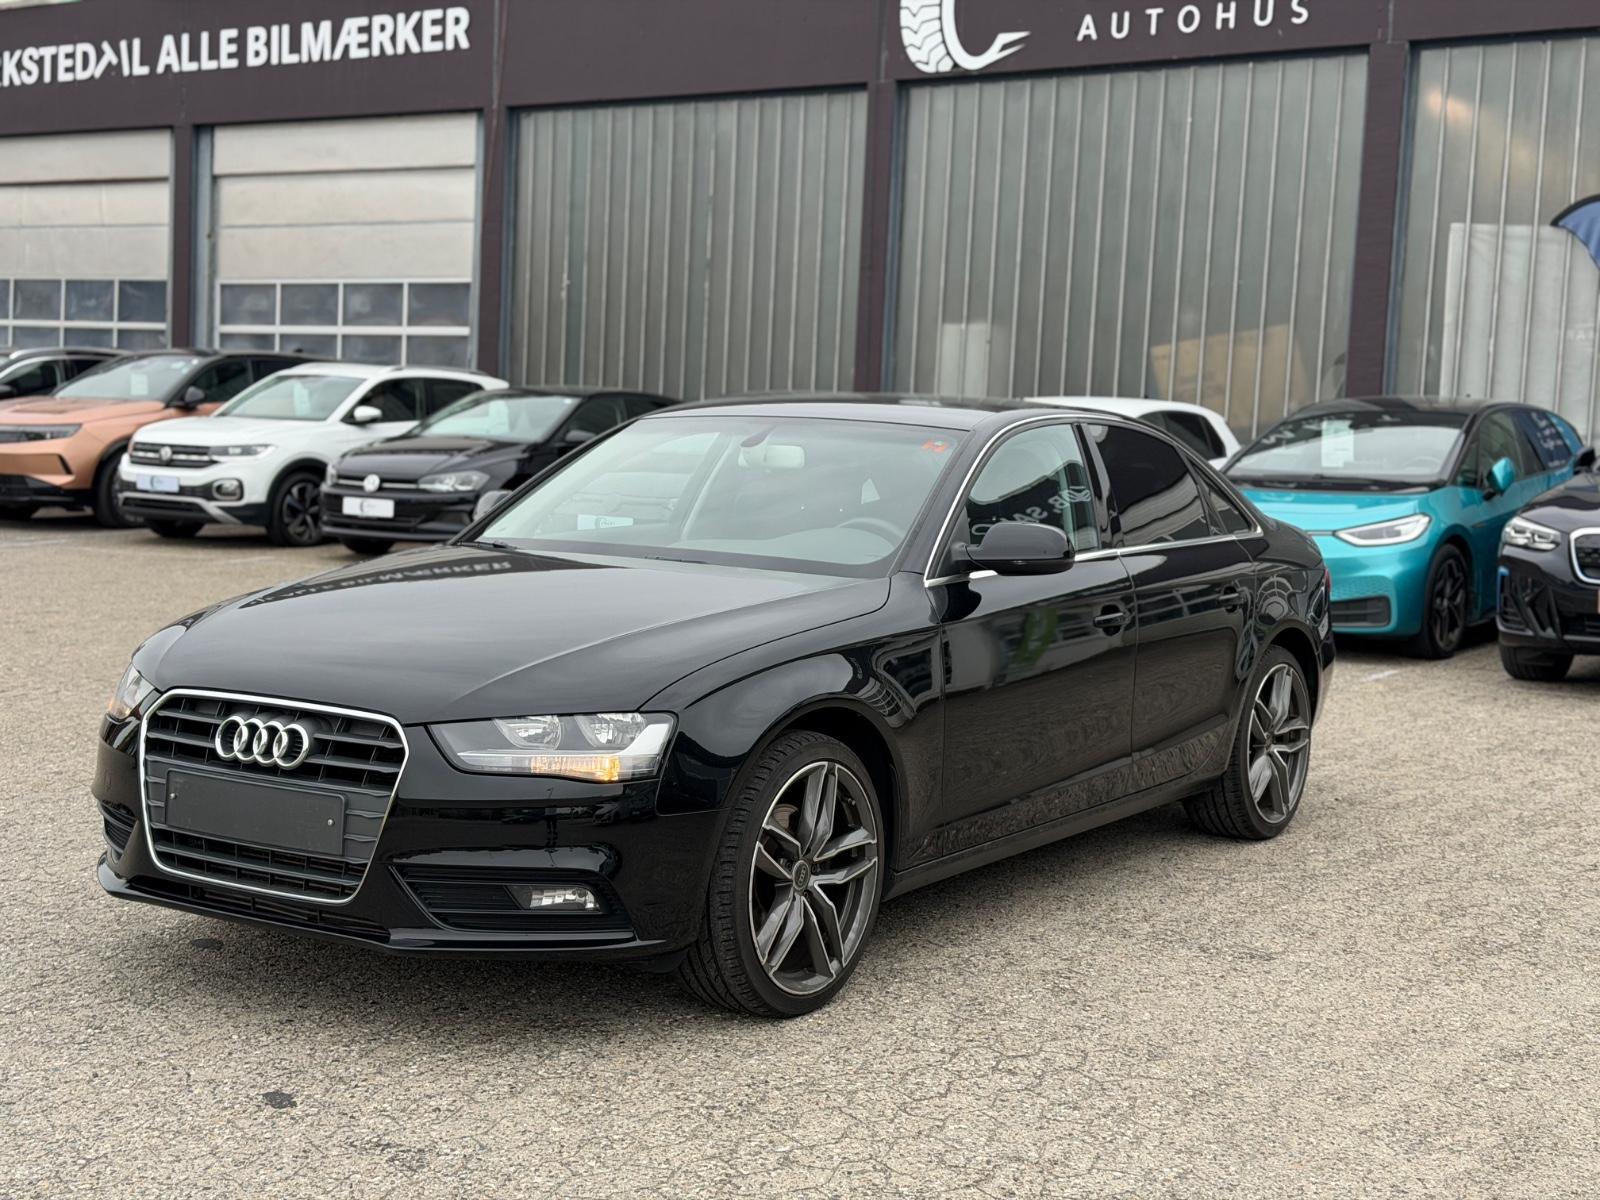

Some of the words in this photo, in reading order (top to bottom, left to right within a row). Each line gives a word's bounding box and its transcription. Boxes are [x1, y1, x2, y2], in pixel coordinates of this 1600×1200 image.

[156, 29, 239, 75] ALLE
[246, 6, 470, 67] BILMÆRKER
[1076, 0, 1310, 42] AUTOHUS
